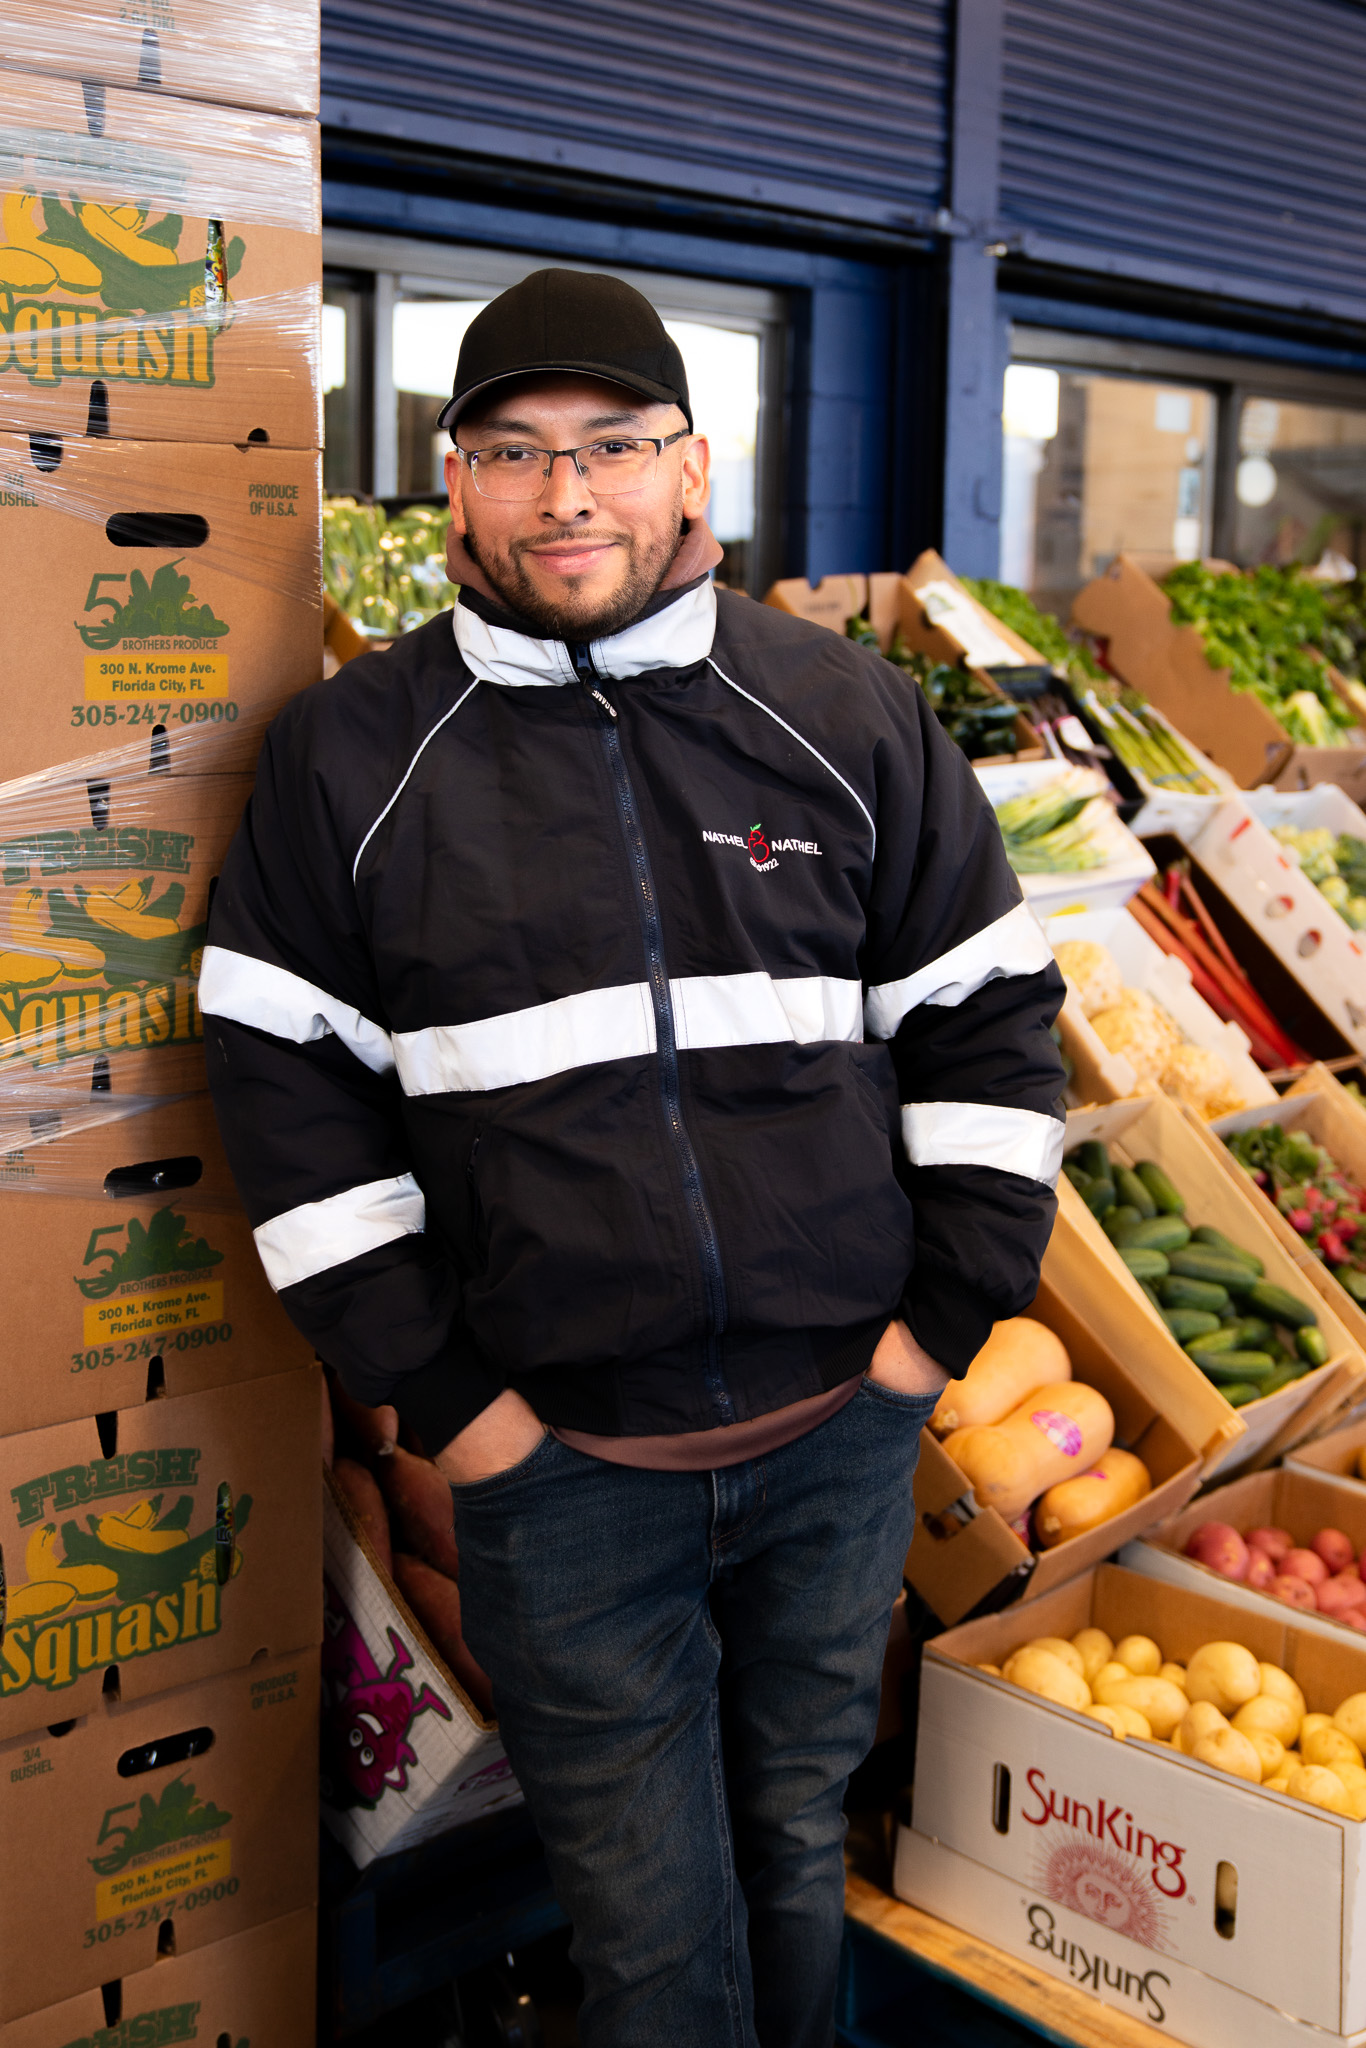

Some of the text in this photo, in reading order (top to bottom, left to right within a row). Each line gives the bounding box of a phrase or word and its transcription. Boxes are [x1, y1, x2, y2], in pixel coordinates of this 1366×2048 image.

[0, 491, 38, 507] USHEL
[248, 484, 299, 499] PRODUCE
[250, 501, 298, 516] OF U.S.A.
[122, 639, 218, 650] BROTHERS PRODUCE
[100, 662, 216, 675] 300 N. Krome Ave.
[112, 679, 205, 693] Florida City, FL
[70, 702, 239, 727] 305-247-0900
[702, 830, 748, 849] NATHEL
[771, 838, 823, 855] NATHEL
[0, 827, 194, 886] FRESH
[0, 1165, 38, 1181] USHEL
[120, 1268, 213, 1295] BROTHERS PRODUCE
[98, 1292, 211, 1321] 300 N. Krome Ave.
[110, 1307, 200, 1335] Florida City, FL
[70, 1323, 233, 1373] 305-247-0900
[10, 1447, 201, 1528] FRESH
[250, 1671, 299, 1696] PRODUCE
[23, 1746, 41, 1763] 3/4
[10, 1759, 54, 1783] BUSHEL
[1021, 1767, 1187, 1899] SunKing
[110, 1852, 219, 1896] 300 N. Krome Ave.
[121, 1885, 163, 1906] Florida
[194, 1868, 208, 1880] FL
[82, 1876, 240, 1948] 305-247-0900
[60, 2000, 201, 2048] ESH
